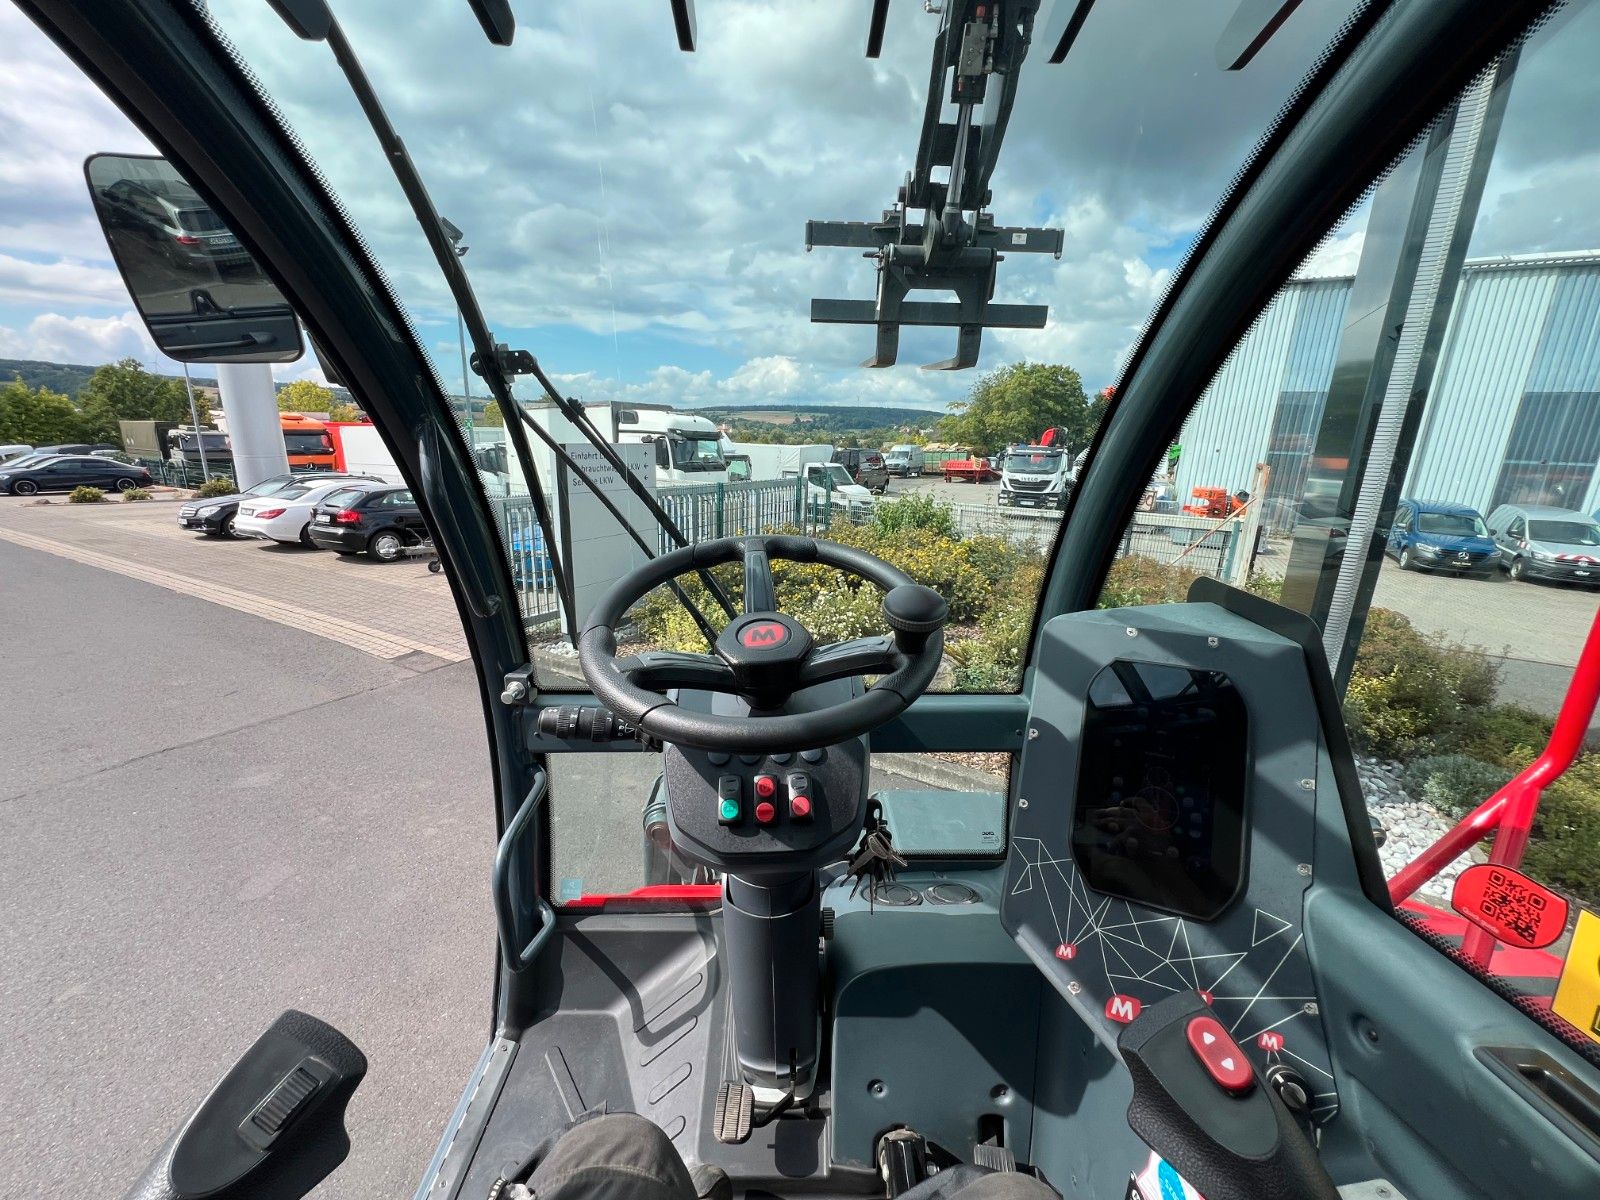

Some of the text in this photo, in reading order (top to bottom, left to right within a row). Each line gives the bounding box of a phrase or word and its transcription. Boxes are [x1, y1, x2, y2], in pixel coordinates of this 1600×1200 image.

[570, 451, 598, 460] Einfahrt
[599, 476, 614, 484] LKW
[1058, 945, 1072, 959] M
[1110, 997, 1134, 1021] M
[1261, 1034, 1278, 1050] M
